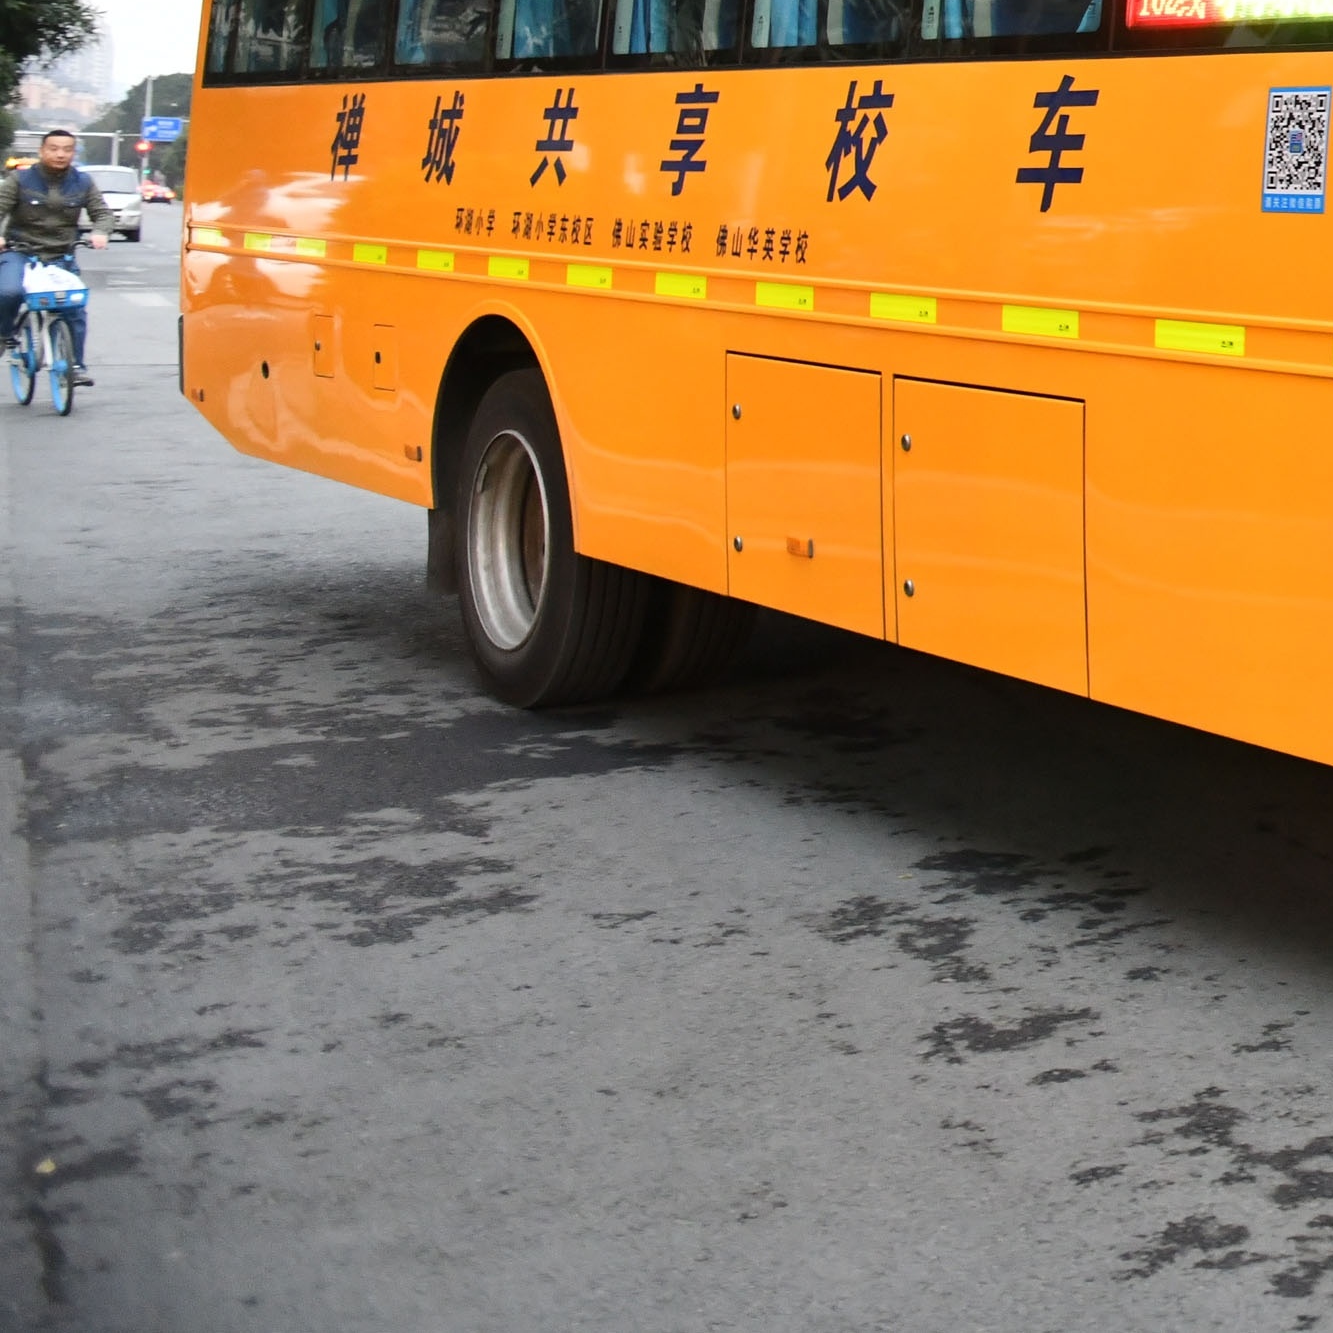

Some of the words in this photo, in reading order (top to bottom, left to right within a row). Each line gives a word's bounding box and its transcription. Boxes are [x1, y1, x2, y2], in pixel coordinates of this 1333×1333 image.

[329, 74, 1100, 213] 禅城共享校车
[454, 207, 496, 238] 环湖小学
[511, 211, 595, 246] 环湖小学东校区
[611, 217, 694, 254] 佛山实验学校
[716, 224, 810, 265] 佛山华英学校
